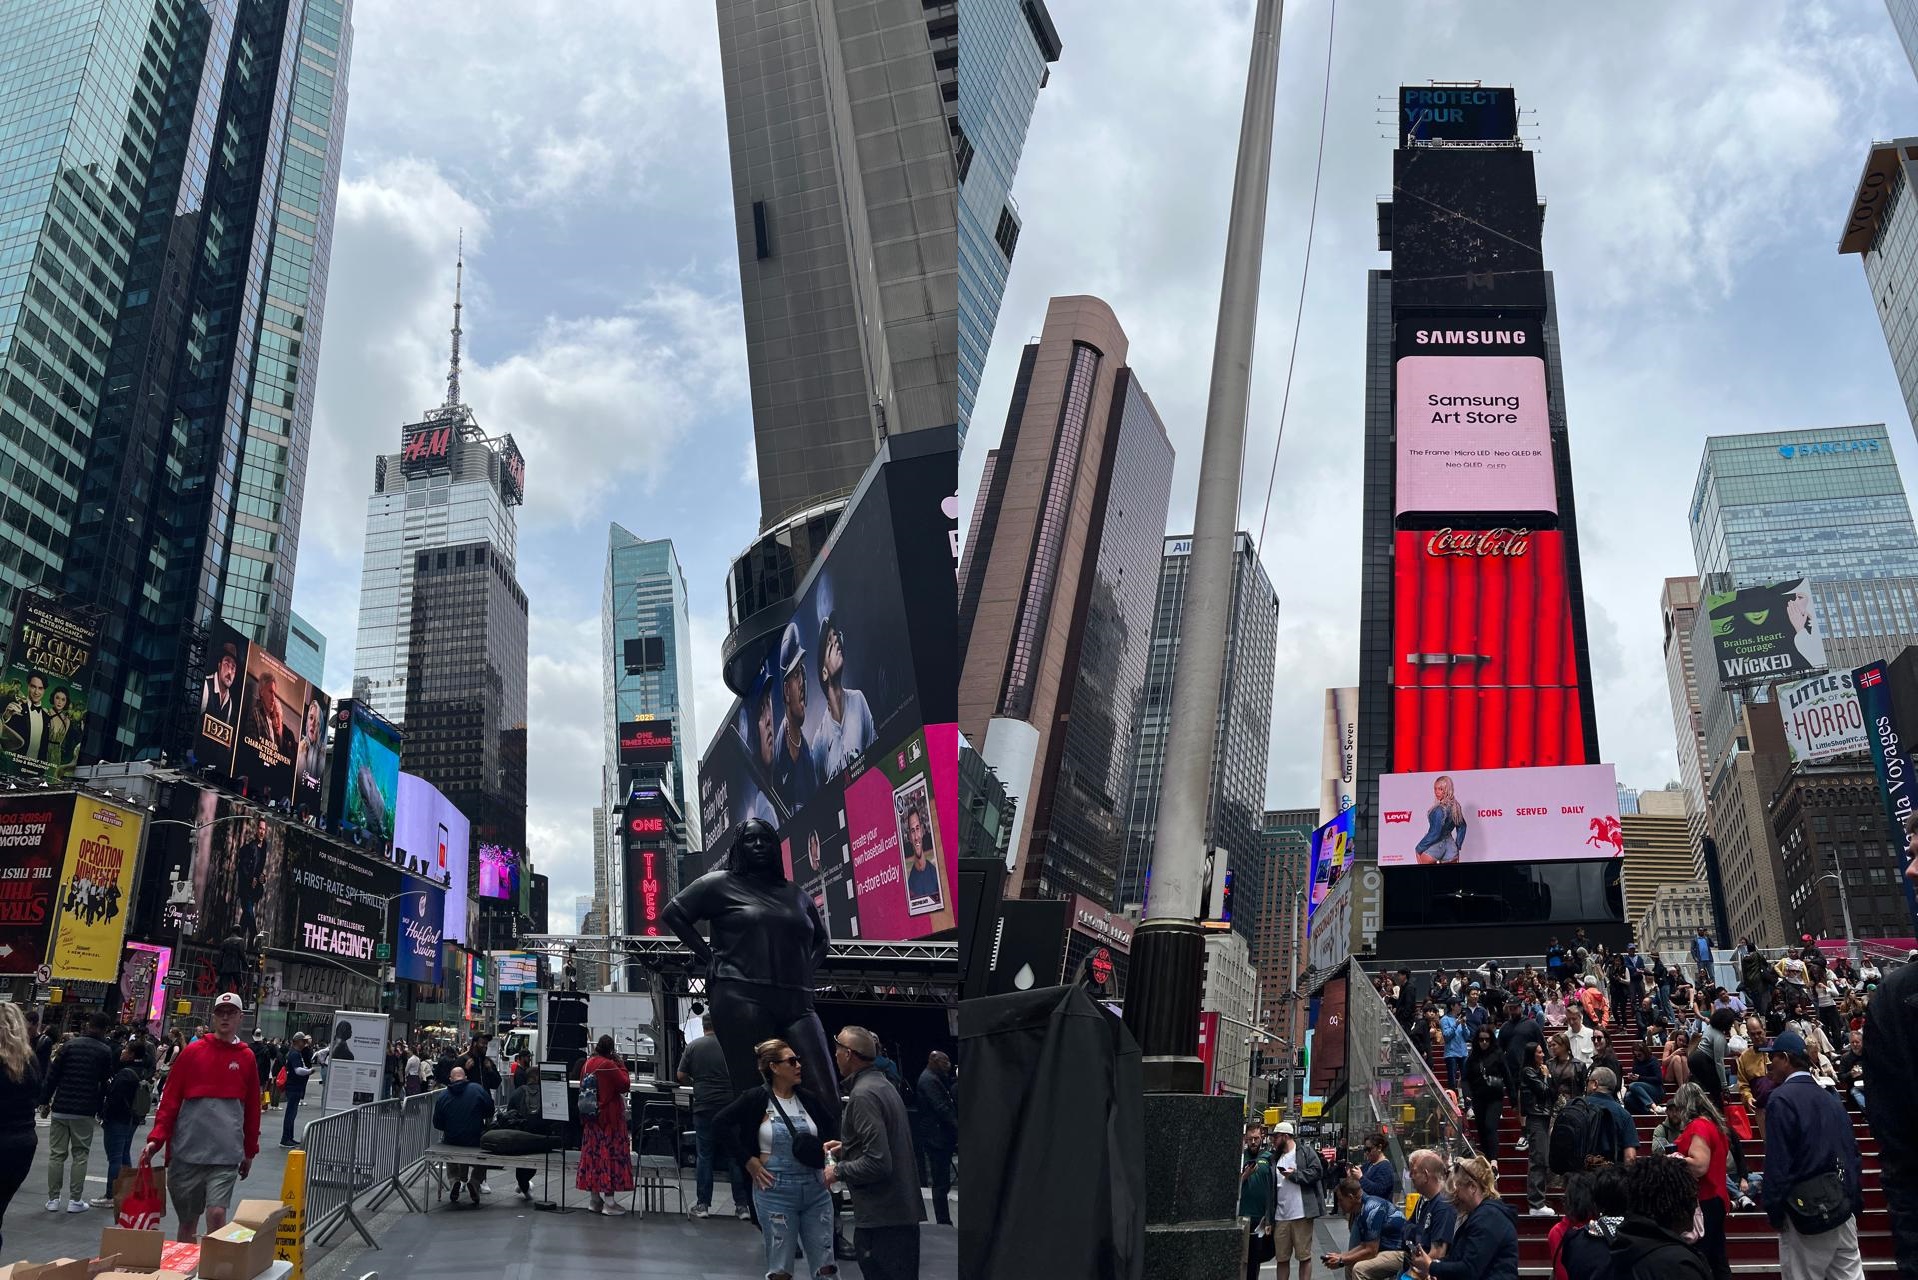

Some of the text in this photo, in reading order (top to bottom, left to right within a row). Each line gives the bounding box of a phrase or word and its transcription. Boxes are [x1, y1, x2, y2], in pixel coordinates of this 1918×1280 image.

[1405, 90, 1499, 105] PROTECT
[1405, 108, 1464, 123] YOUR
[1416, 330, 1526, 344] SAMSUNG
[1428, 394, 1520, 410] Samsung
[1431, 412, 1518, 424] Art Store
[403, 426, 453, 461] H&M
[1799, 439, 1880, 457] BARCLAYS
[23, 628, 89, 666] THE GREAT
[1723, 632, 1786, 648] Brains. Heart.
[1735, 642, 1776, 655] Courage.
[26, 647, 81, 676] GATSBY
[1789, 676, 1839, 709] LITTLE
[635, 713, 655, 721] 2025
[207, 719, 230, 742] 1923
[1344, 723, 1354, 751] Seven
[621, 737, 672, 747] TIMES SQUARE
[1876, 715, 1905, 795] Voyages
[1343, 754, 1352, 783] Crane
[1477, 805, 1585, 818] ICONS SERVED DAILY
[25, 824, 46, 834] HAS
[632, 819, 663, 831] ONE
[852, 827, 878, 851] create your
[79, 838, 124, 868] OPERATION
[854, 832, 898, 867] own baseball card
[2, 867, 52, 879] THE FIRST
[857, 872, 881, 896] in-store
[880, 865, 900, 885] today
[304, 871, 345, 897] FIRST-RATE
[642, 853, 657, 920] TIMES
[317, 914, 365, 932] CENTRAL INTELLIGENCE
[303, 922, 330, 951] THE
[413, 939, 436, 958] Swim
